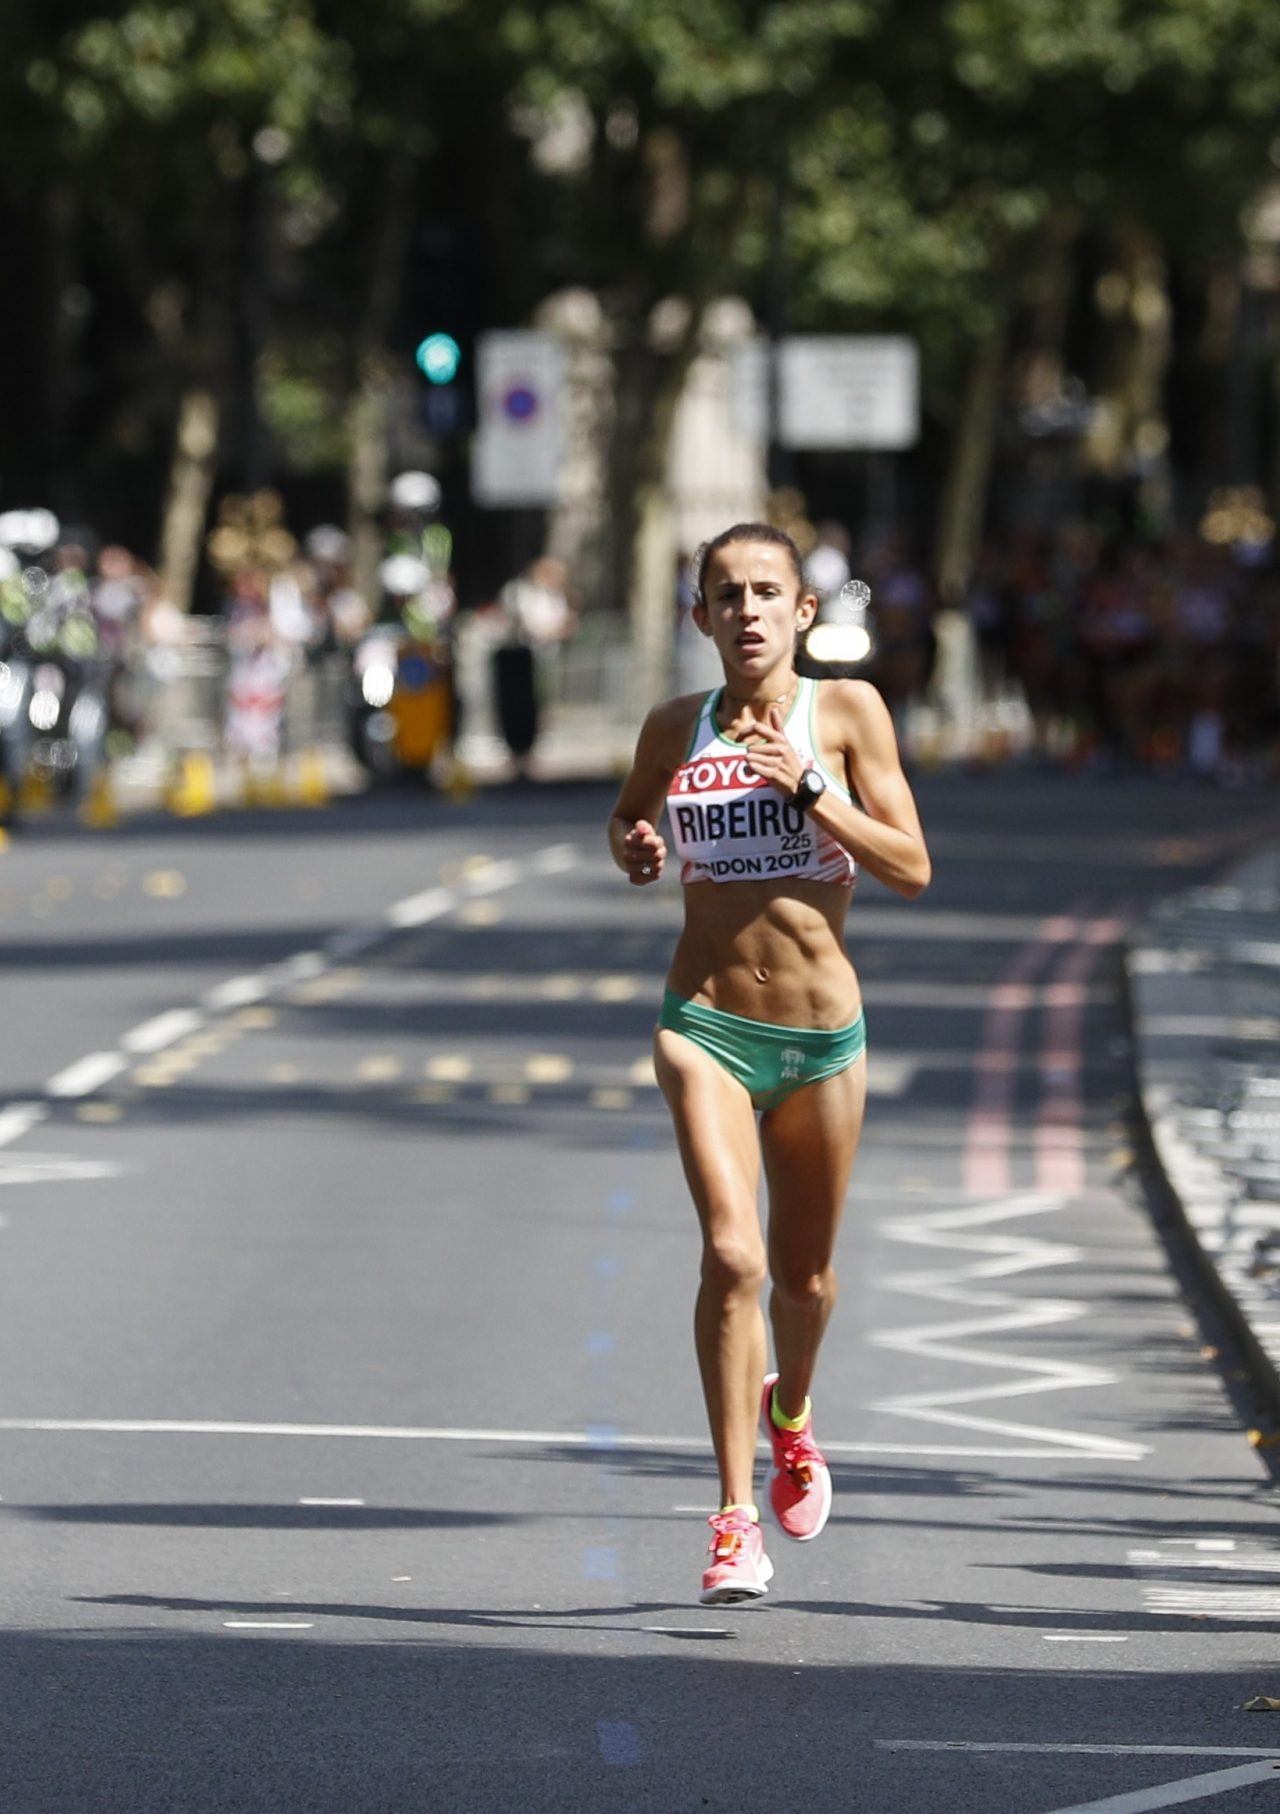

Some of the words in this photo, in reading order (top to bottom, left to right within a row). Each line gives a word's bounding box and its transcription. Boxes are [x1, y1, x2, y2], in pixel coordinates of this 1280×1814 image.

[677, 759, 761, 793] TOYO
[676, 799, 805, 844] RIBEIRO
[780, 833, 812, 851] 225
[765, 851, 812, 872] 2017
